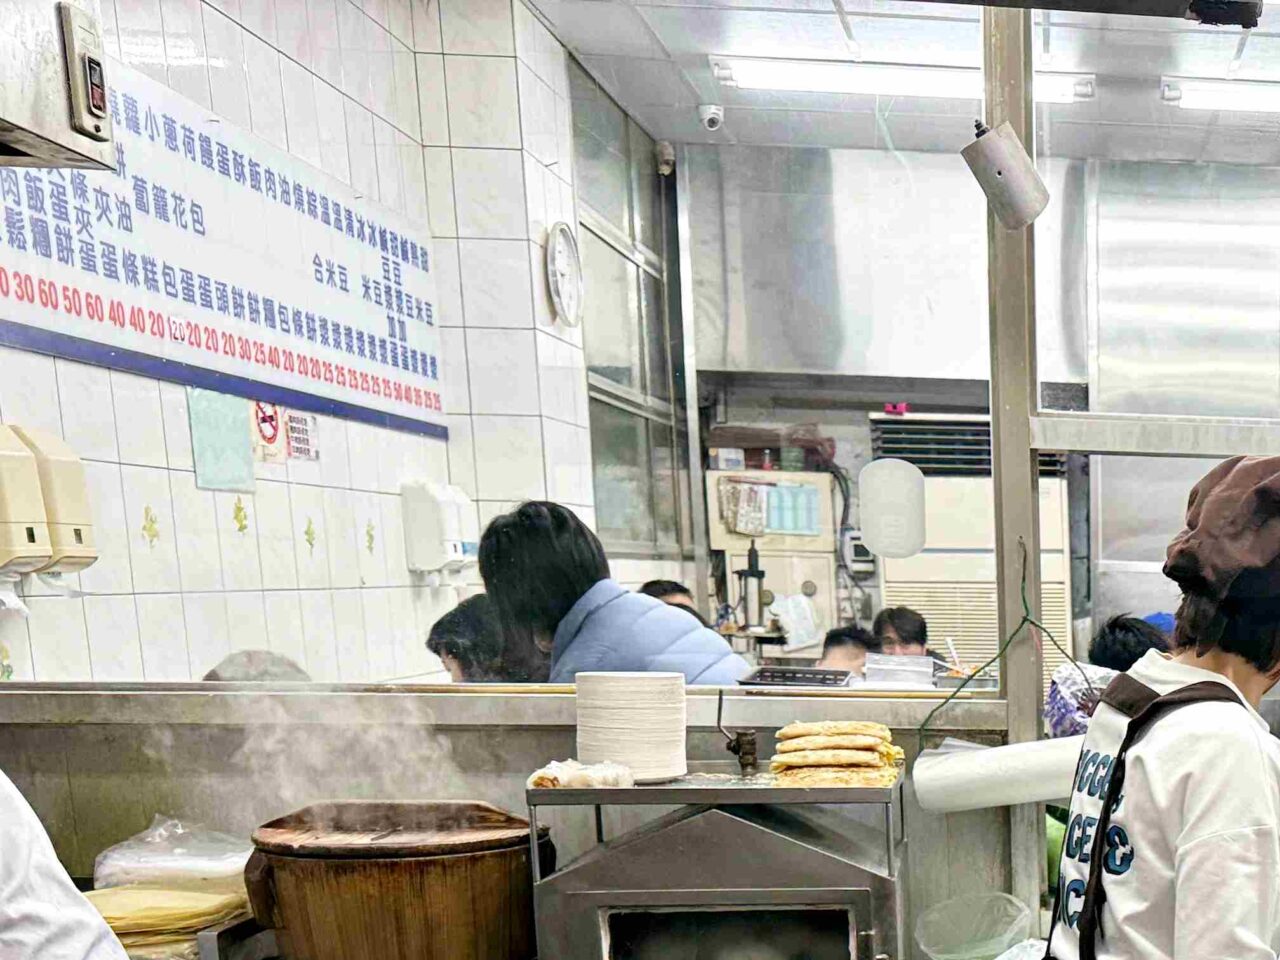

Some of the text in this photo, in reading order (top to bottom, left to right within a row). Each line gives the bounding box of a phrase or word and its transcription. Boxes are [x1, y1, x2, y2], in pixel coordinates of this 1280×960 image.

[13, 271, 35, 304] 30
[38, 277, 59, 310] 60
[62, 285, 82, 317] 50
[86, 291, 104, 323] 60
[108, 299, 126, 329] 40
[129, 304, 146, 334] 40
[148, 309, 165, 339] 20
[186, 320, 202, 348] 20
[204, 325, 219, 353] 20
[221, 331, 236, 358] 20
[237, 336, 252, 362] 30
[253, 340, 266, 366] 25
[268, 344, 280, 369] 40
[282, 348, 295, 373] 20
[297, 352, 308, 376] 20
[310, 356, 321, 380] 20
[322, 360, 334, 384] 25
[335, 364, 346, 387] 25
[348, 368, 359, 391] 25
[359, 371, 370, 394] 25
[371, 374, 381, 396] 25
[382, 377, 392, 399] 25
